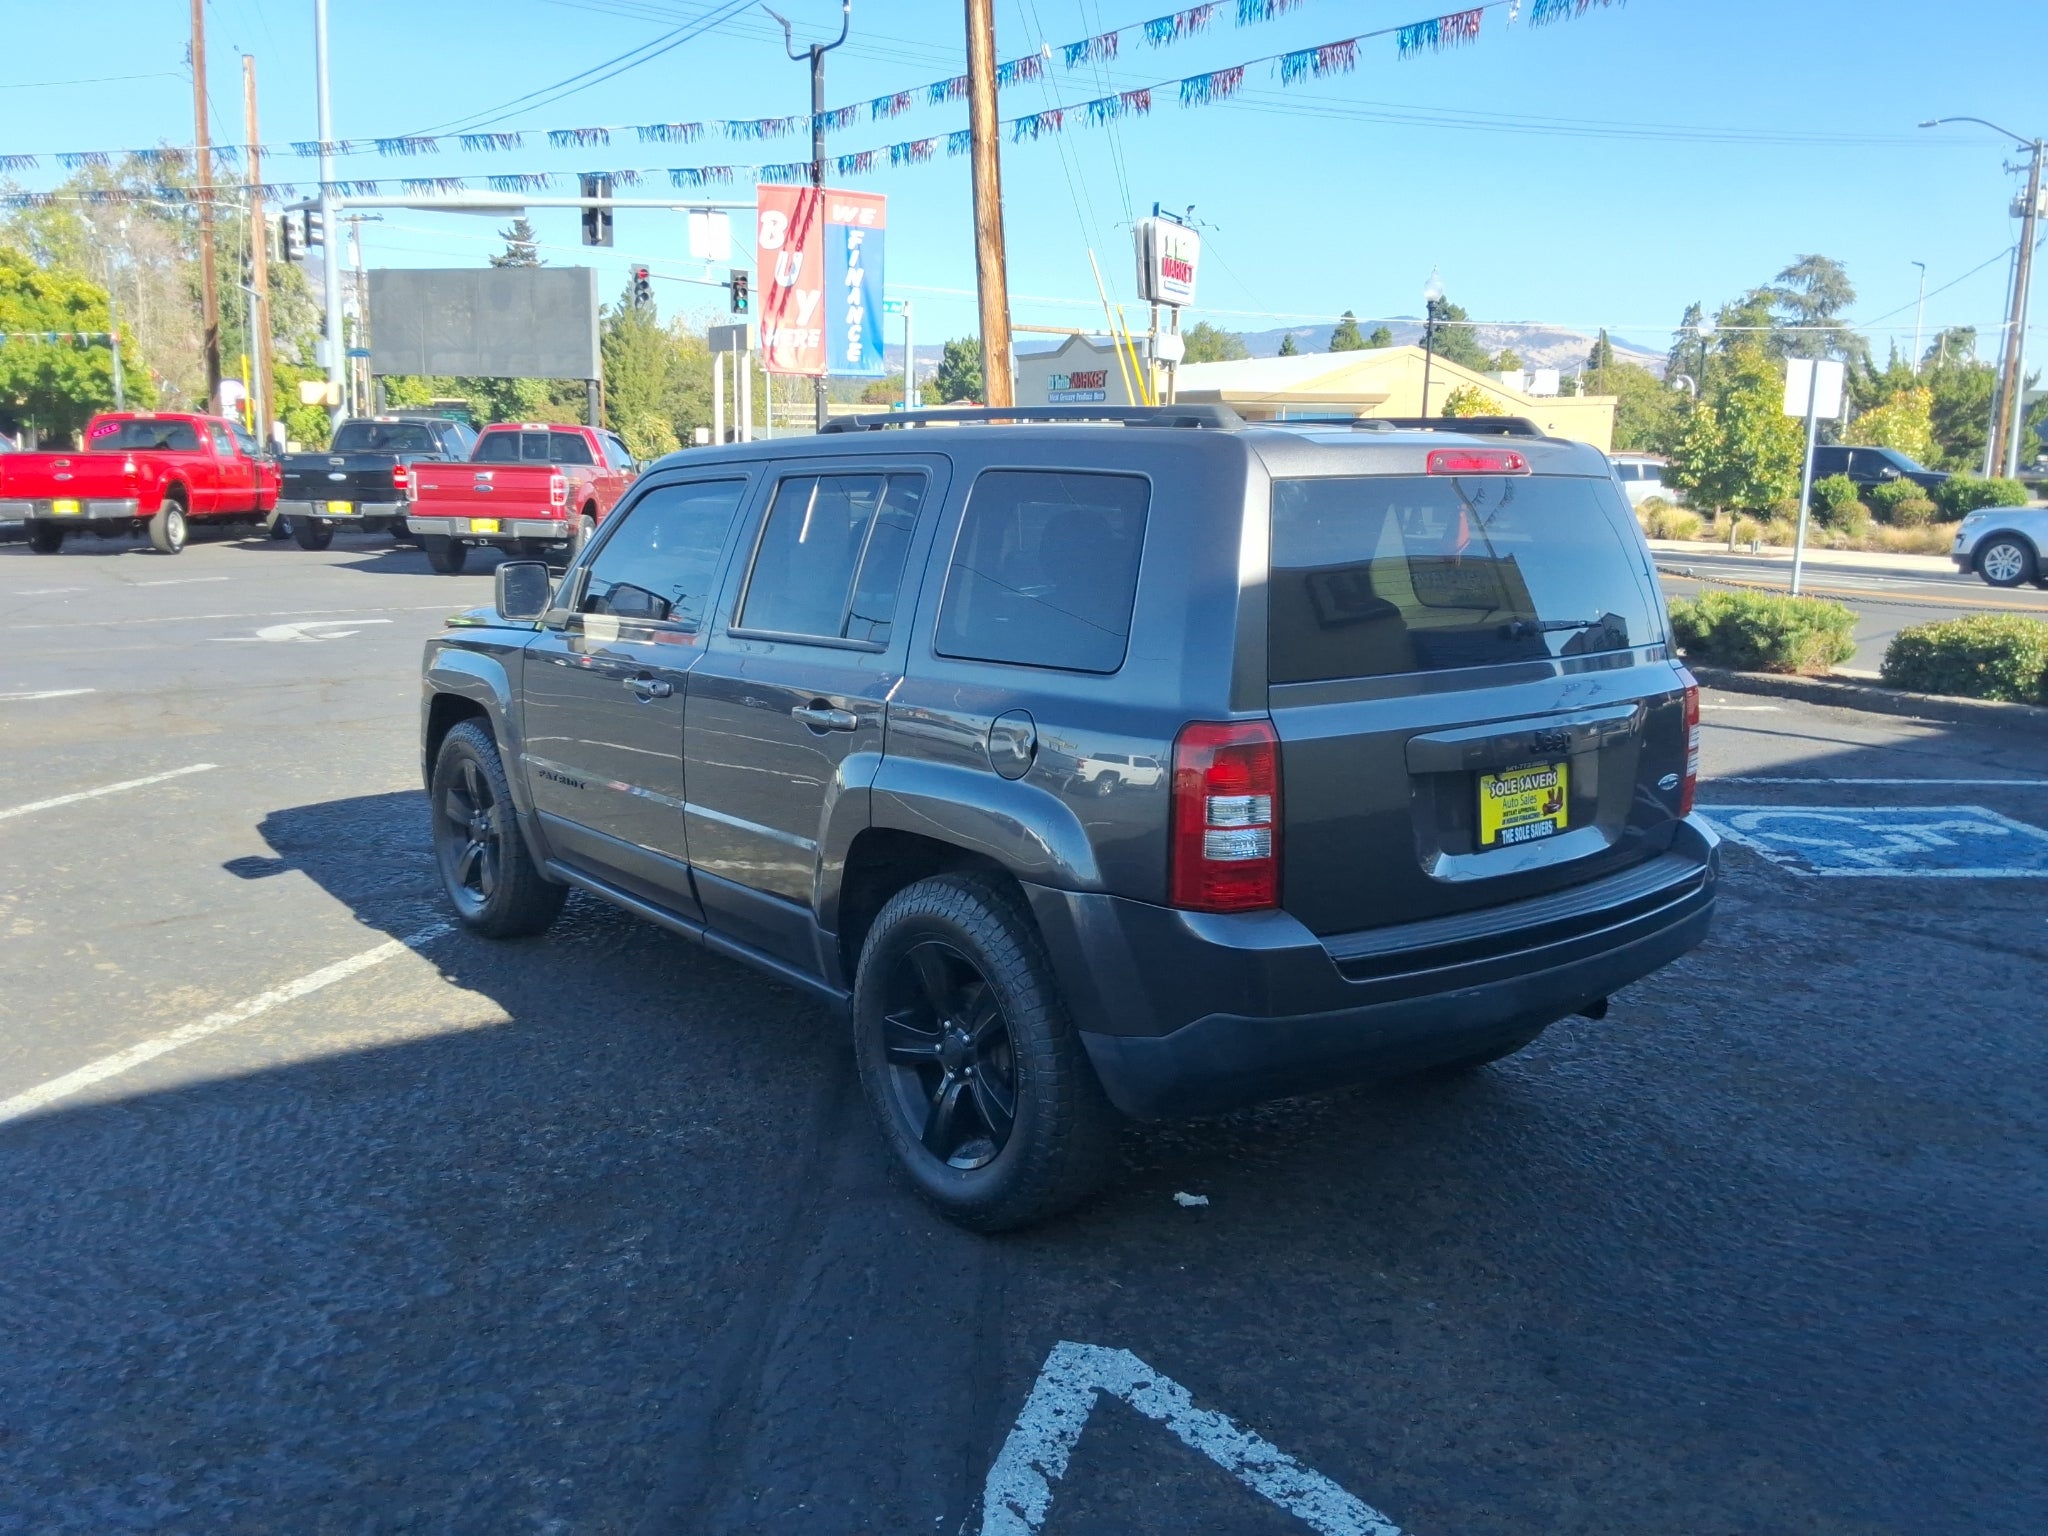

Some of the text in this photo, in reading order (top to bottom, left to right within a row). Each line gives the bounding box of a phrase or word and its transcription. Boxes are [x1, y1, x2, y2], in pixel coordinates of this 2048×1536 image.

[832, 204, 877, 224] WE
[758, 210, 822, 326] BUY
[844, 229, 865, 362] FINANCE
[765, 328, 822, 350] HERE
[1490, 772, 1557, 798] SOLE SAVERS
[1503, 794, 1537, 809] Auto Sales
[1502, 820, 1553, 845] THE SOLE SAVERS
